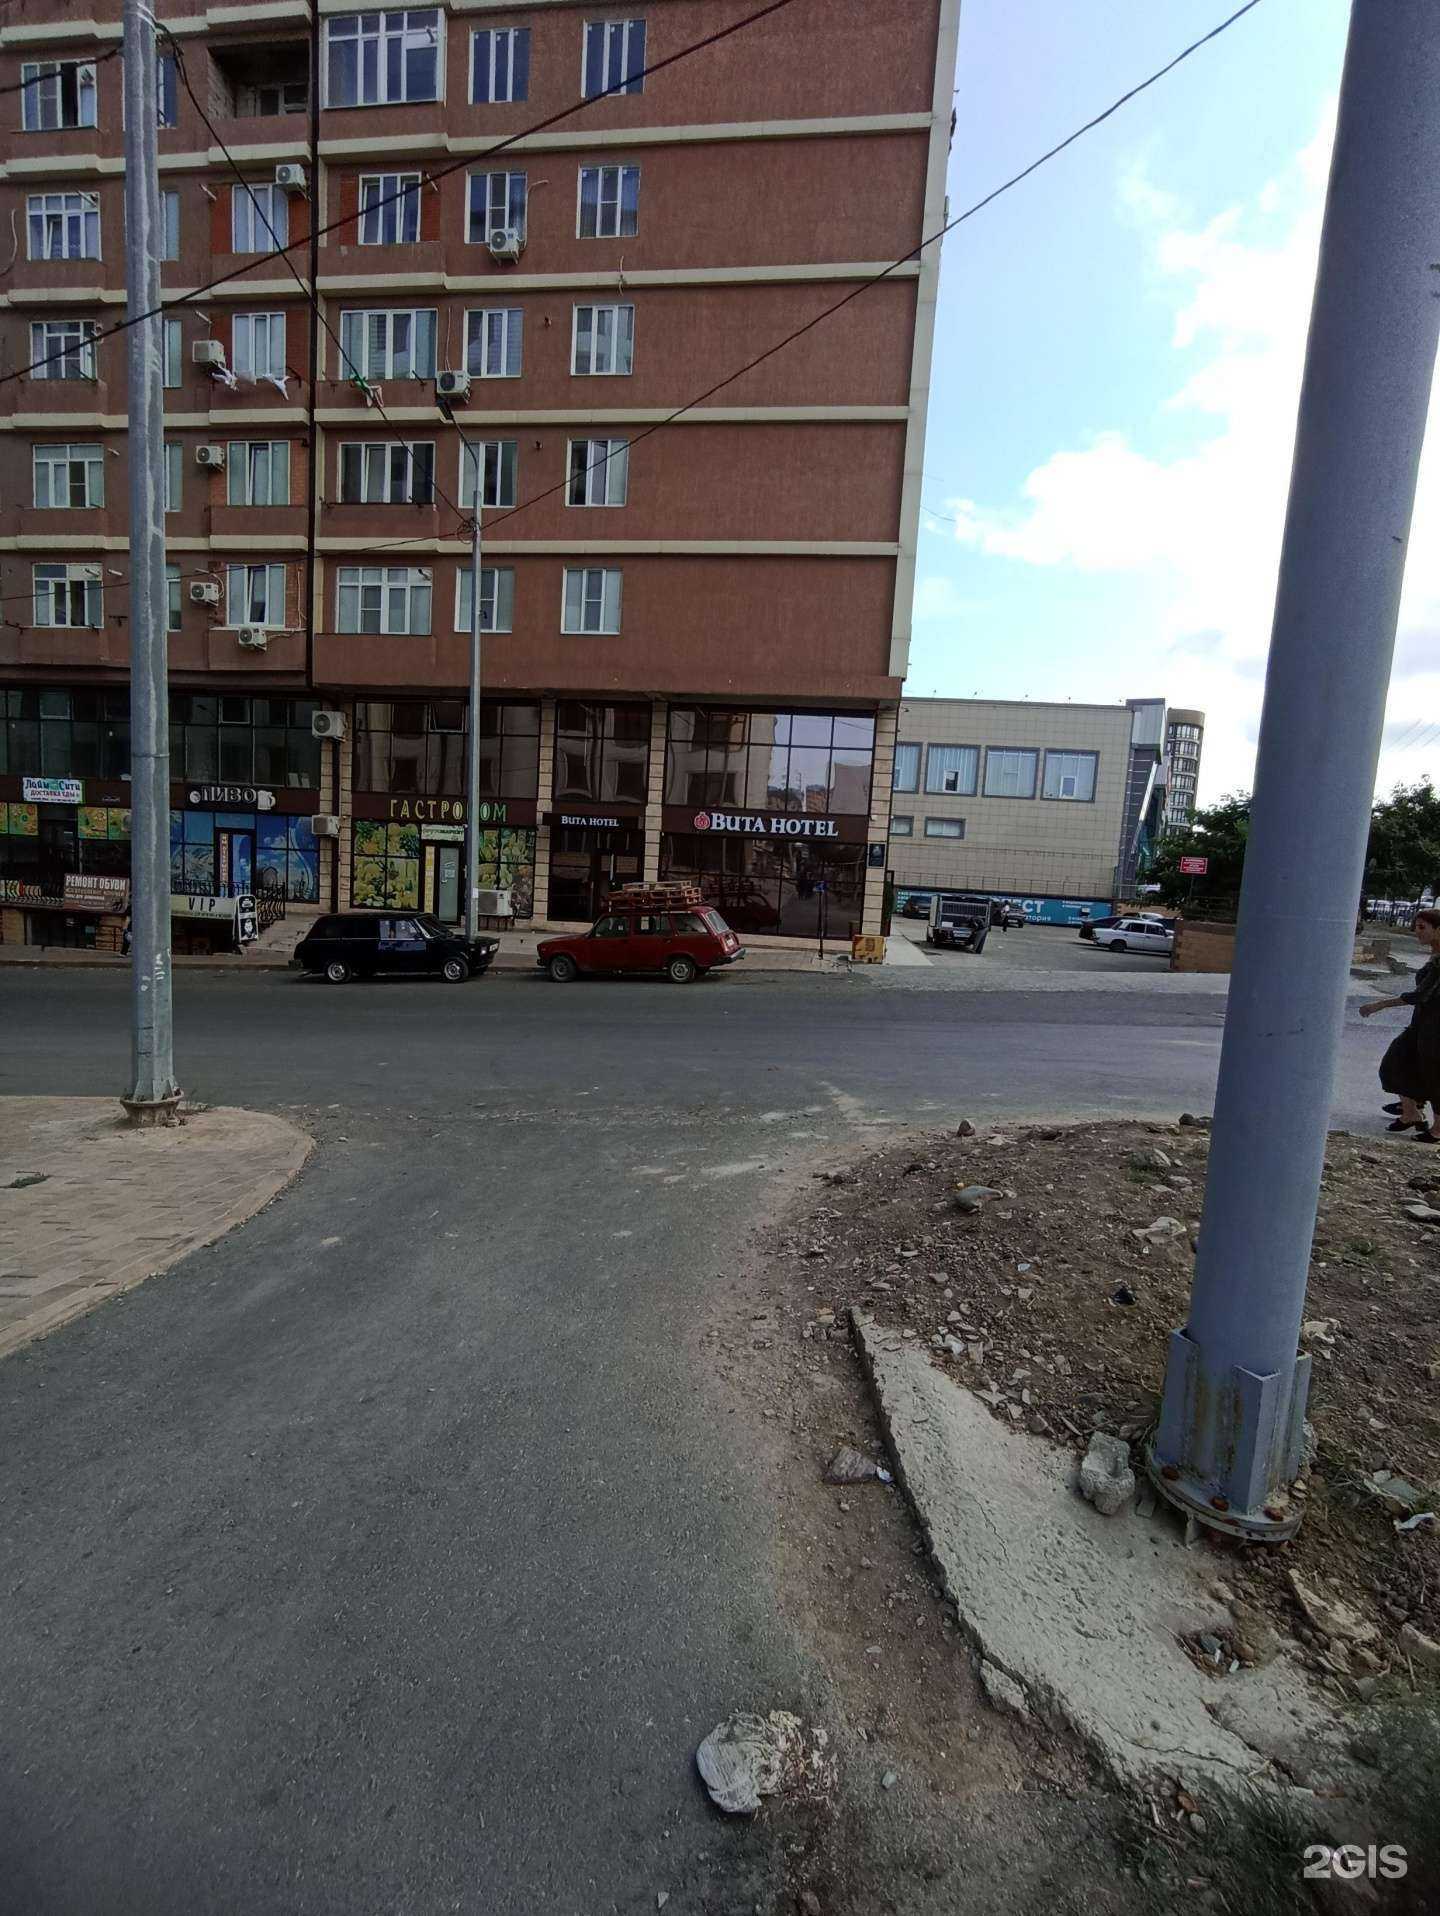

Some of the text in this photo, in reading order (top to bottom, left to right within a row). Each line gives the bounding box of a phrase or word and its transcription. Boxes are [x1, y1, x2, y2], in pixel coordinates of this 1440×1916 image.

[202, 785, 257, 803] ПИВО
[389, 798, 508, 823] ГАСТРООМ
[560, 815, 620, 828] BUTA HOTEL
[710, 811, 839, 838] BUTA HOTEL
[65, 874, 126, 891] РЕМОНТ ОБУВИ
[188, 897, 216, 912] VIP
